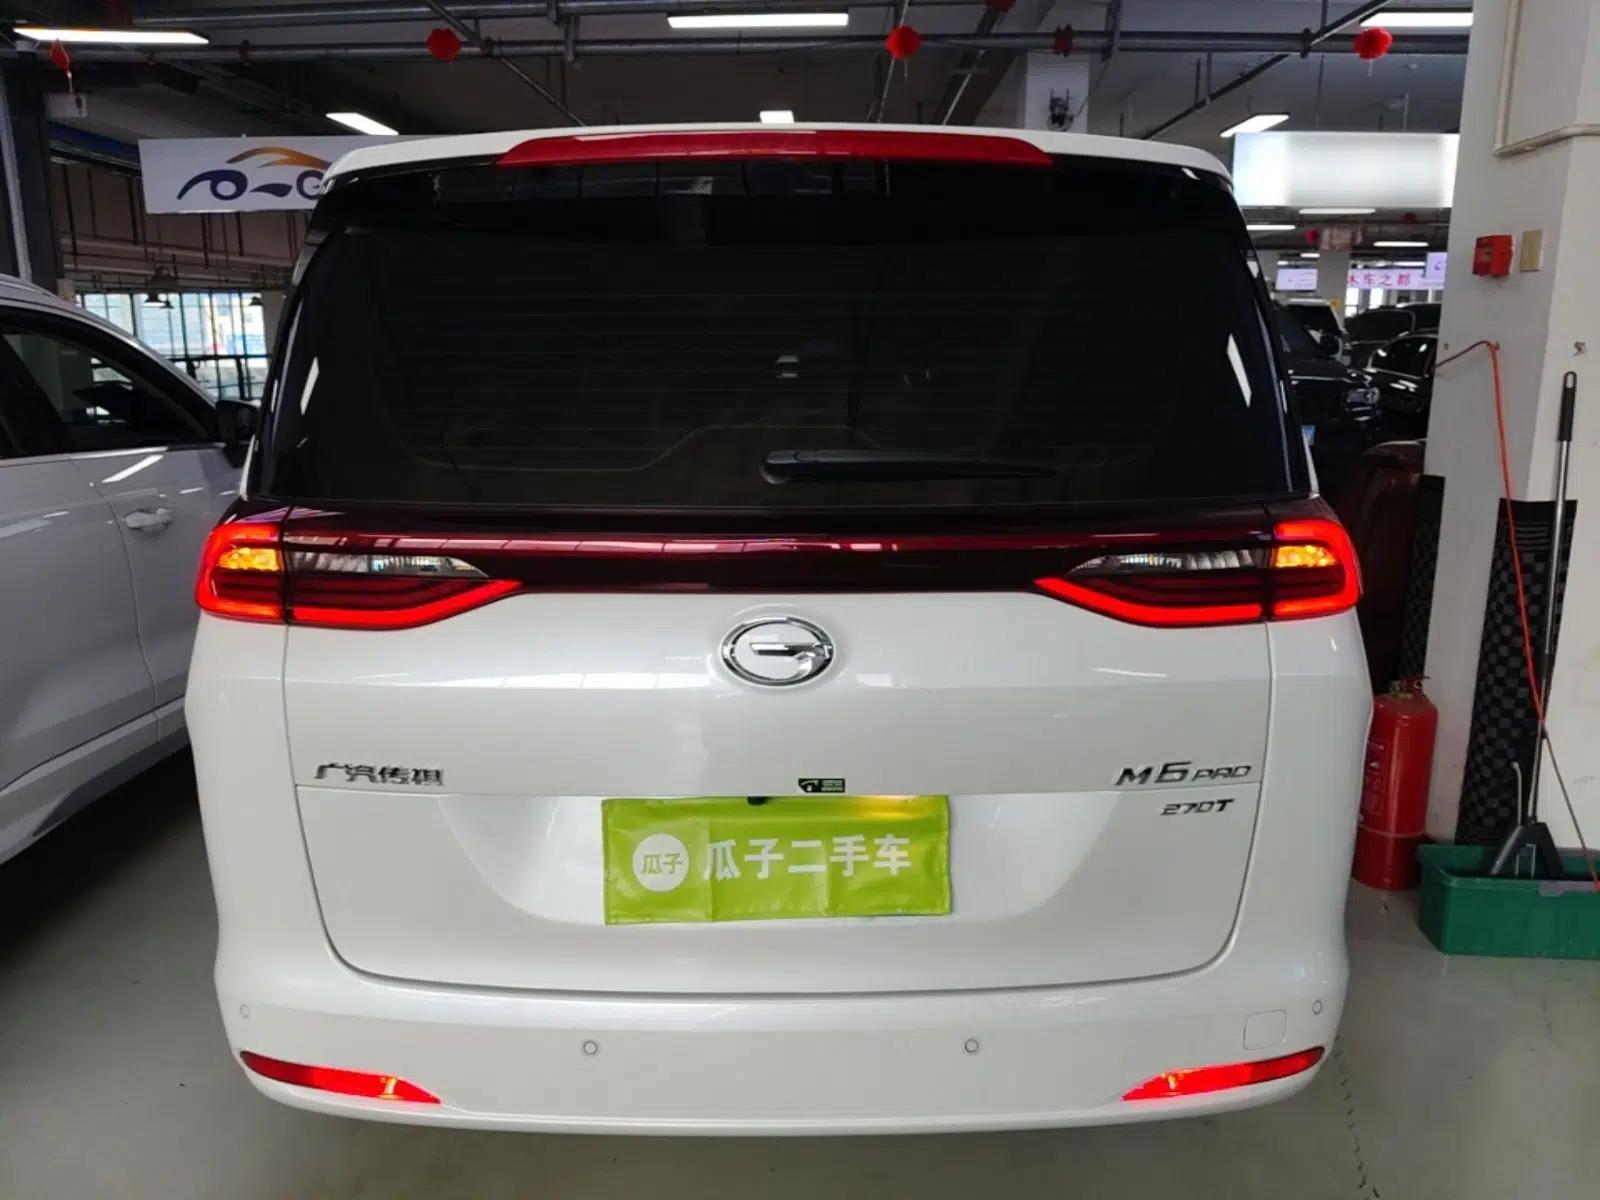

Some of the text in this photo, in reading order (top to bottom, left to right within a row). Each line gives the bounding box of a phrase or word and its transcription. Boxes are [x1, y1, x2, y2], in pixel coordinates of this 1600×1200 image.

[314, 763, 444, 785] 广汽传祺
[1160, 798, 1235, 816] 270T
[641, 852, 683, 875] 瓜子
[703, 834, 912, 881] 瓜子二手车
